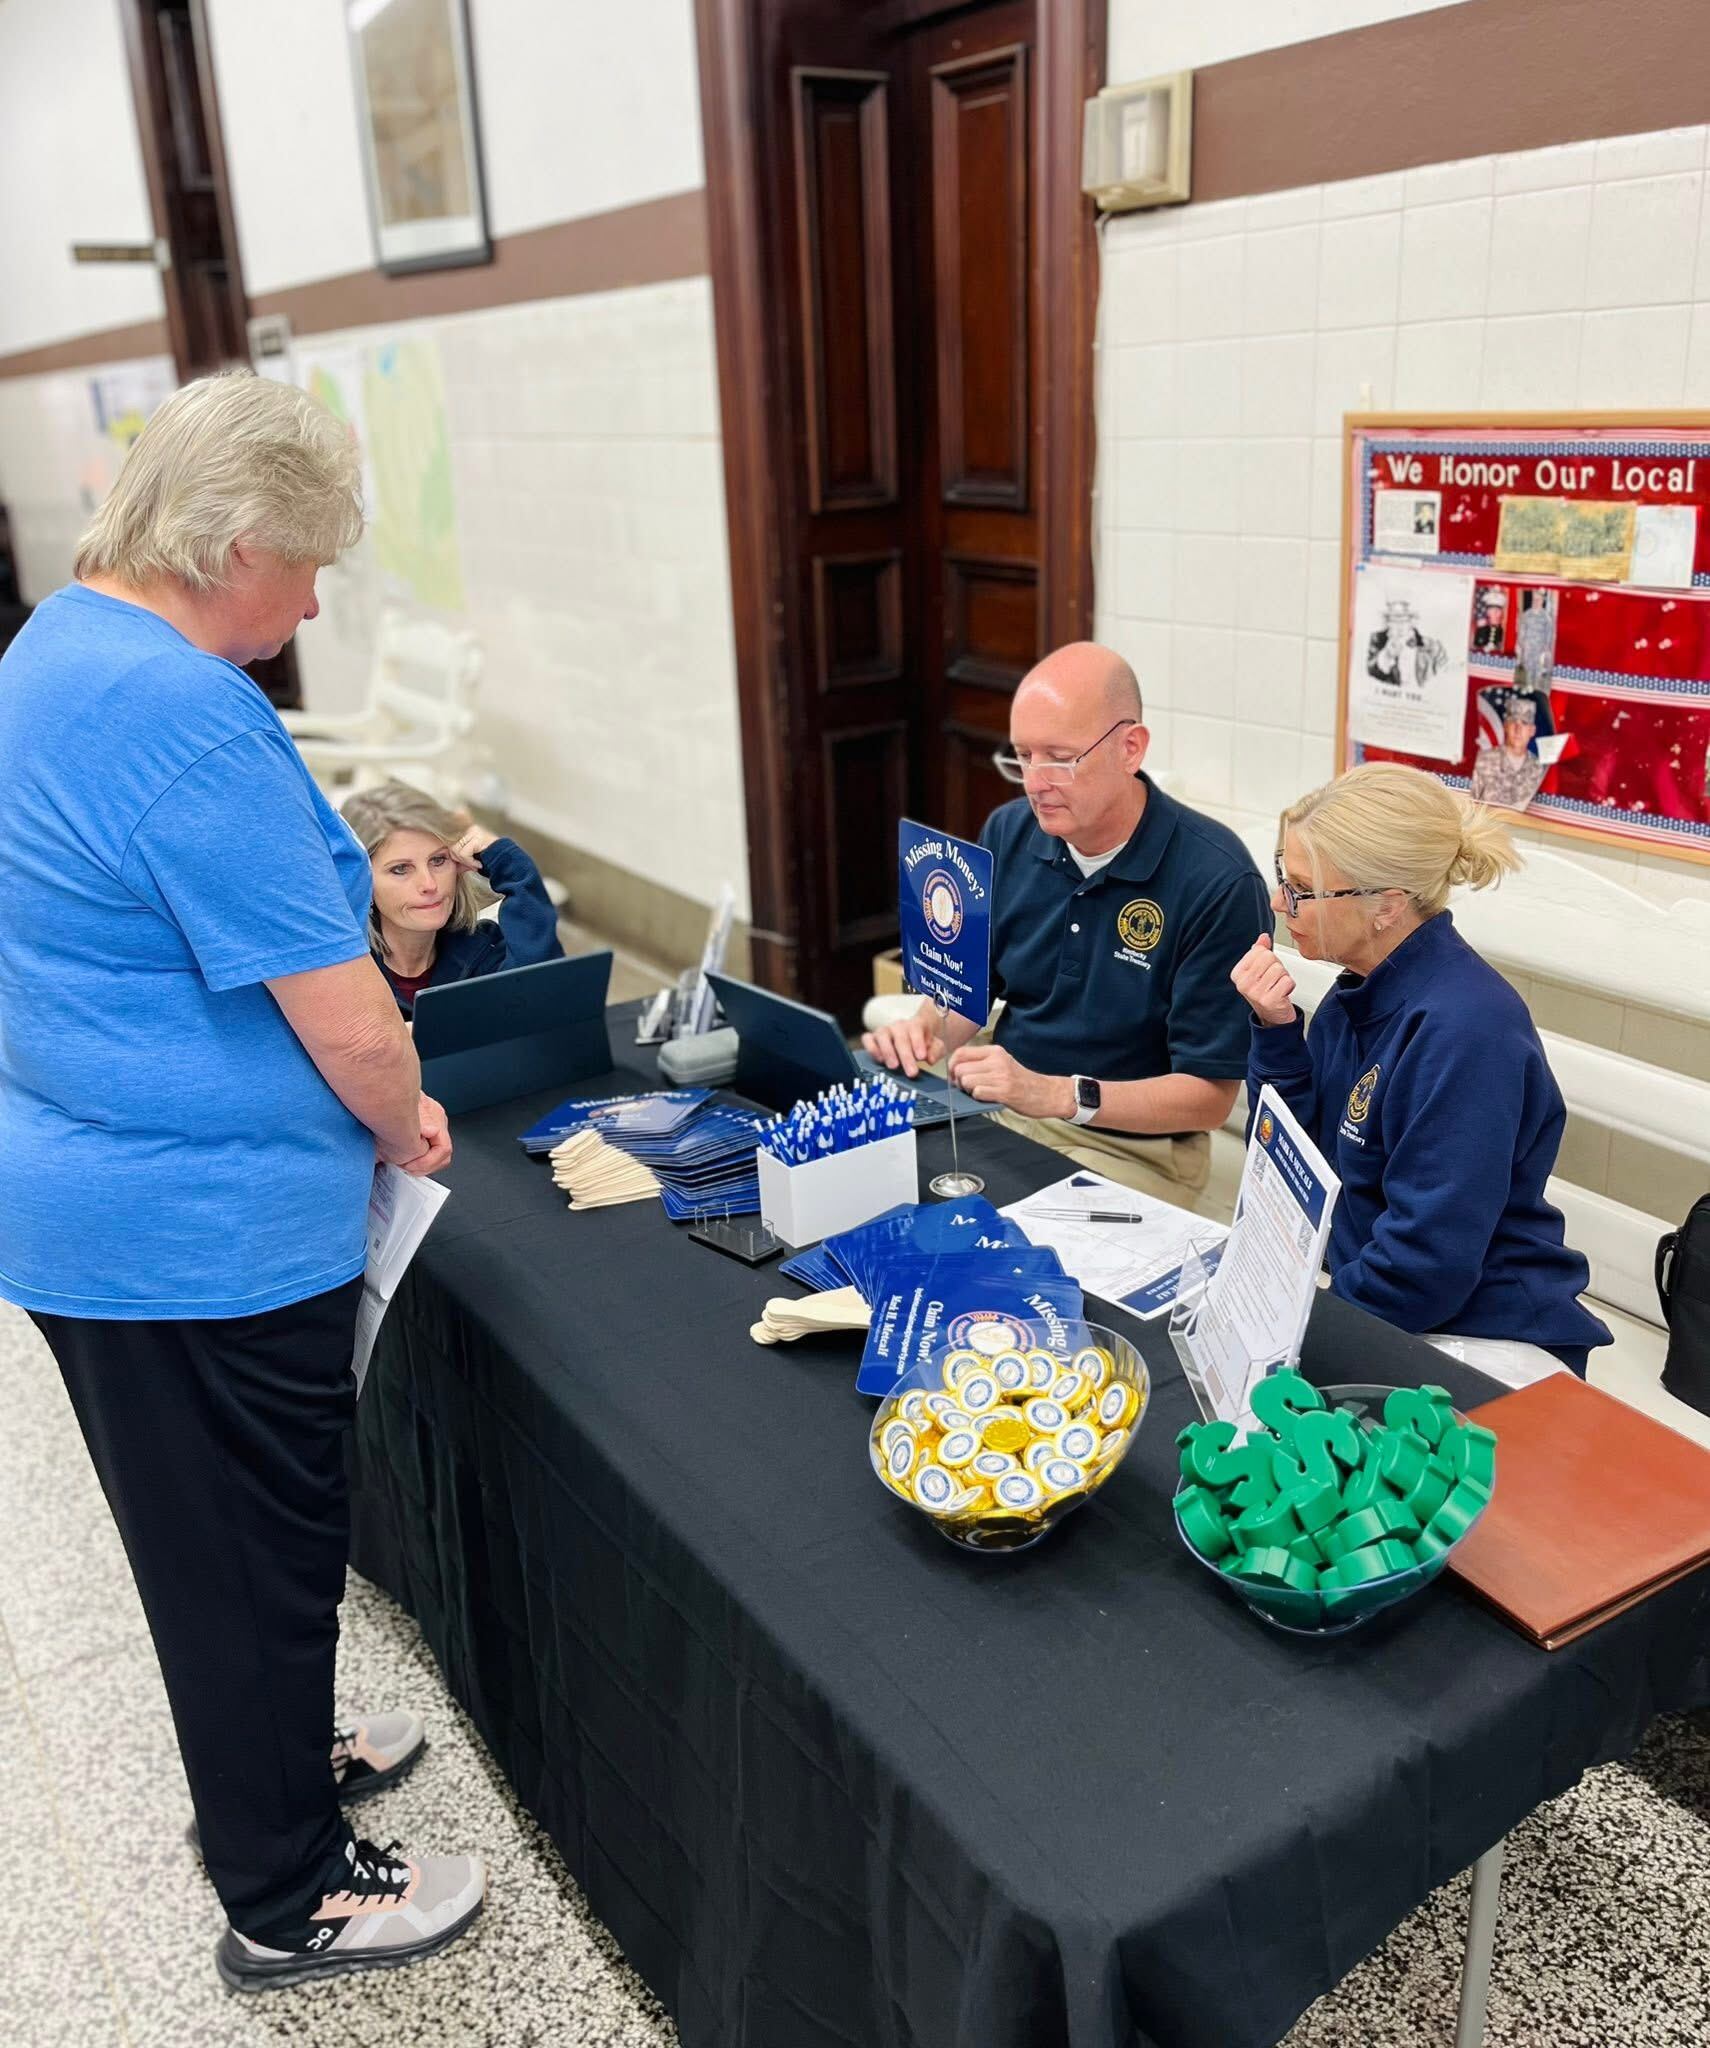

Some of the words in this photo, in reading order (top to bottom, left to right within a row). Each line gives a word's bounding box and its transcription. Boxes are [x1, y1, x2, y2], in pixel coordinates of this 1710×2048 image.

[1386, 455, 1424, 484] We
[1439, 455, 1520, 487] Honor
[1535, 460, 1596, 490] Our
[1612, 460, 1696, 493] Local
[904, 838, 943, 873] Missing
[945, 839, 985, 900] Money?
[920, 941, 942, 963] Claim
[943, 952, 964, 975] Now!
[888, 1294, 903, 1311] Mark
[923, 1300, 944, 1328] Claim
[1022, 1293, 1069, 1350] Missing
[877, 1322, 895, 1358] Metcalf
[916, 1329, 938, 1364] Now!
